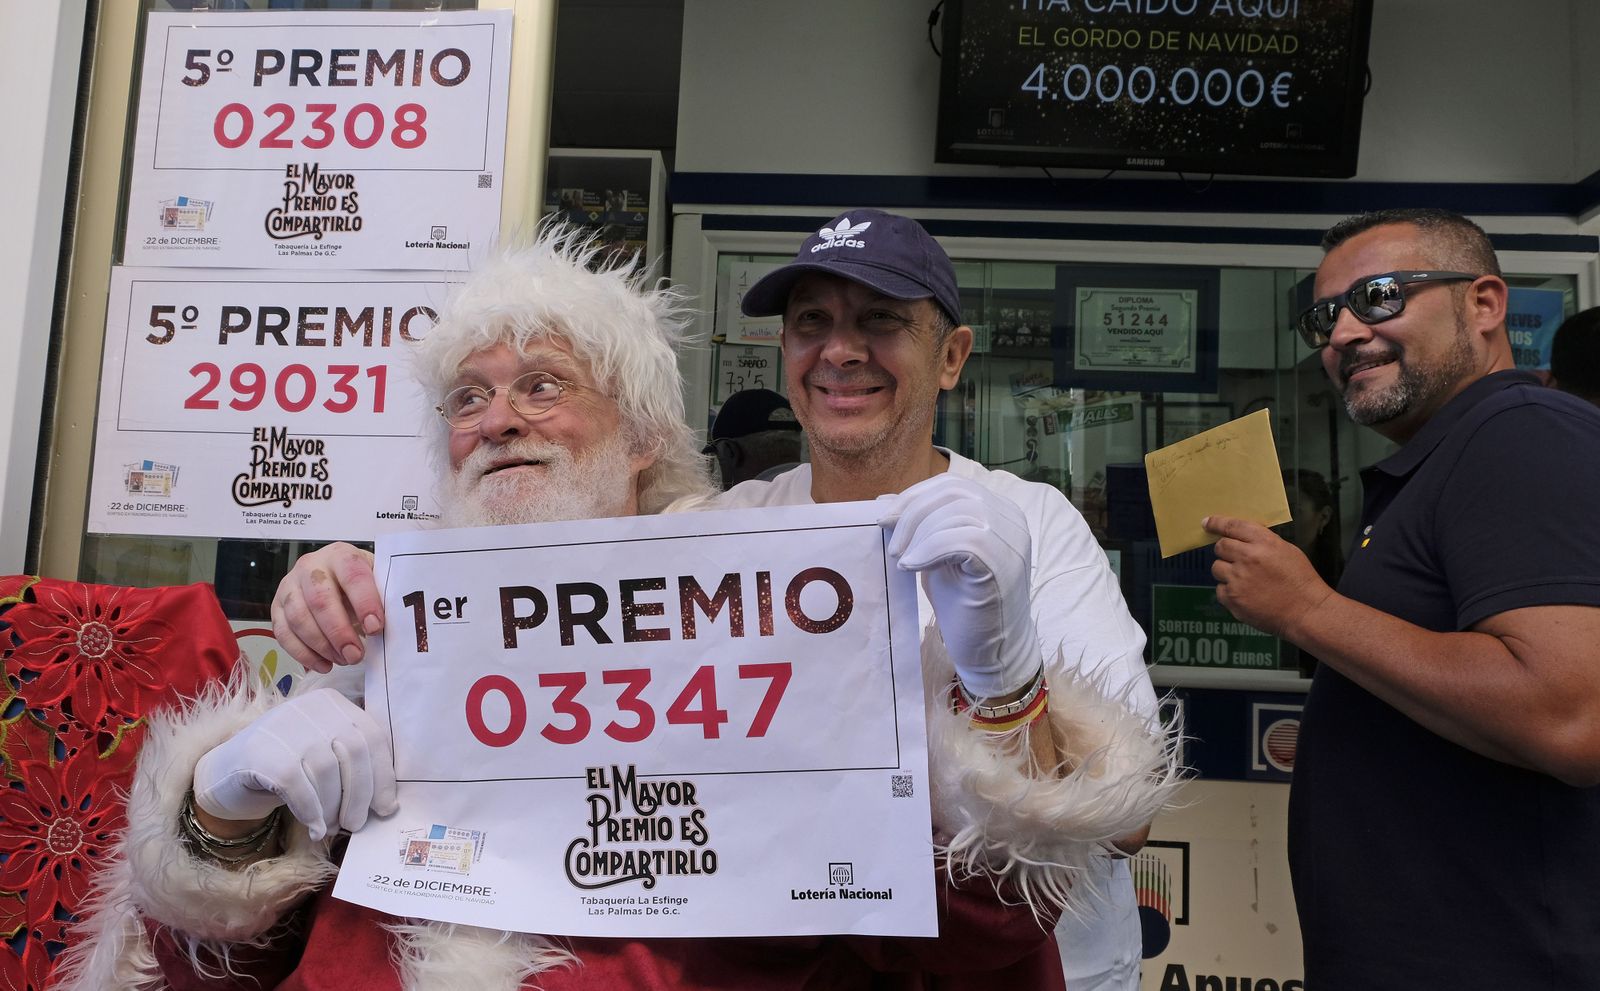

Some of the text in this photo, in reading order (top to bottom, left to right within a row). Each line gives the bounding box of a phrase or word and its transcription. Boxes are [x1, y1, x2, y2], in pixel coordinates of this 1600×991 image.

[1018, 26, 1299, 54] EL GORDO DE NAVIDAD
[253, 47, 471, 87] PREMIO
[1020, 62, 1295, 108] 4.000.000€
[213, 102, 428, 150] 02308
[1126, 157, 1166, 166] SAMSUNG
[286, 162, 355, 195] EL MAYOR
[282, 180, 337, 214] PREMIO
[265, 207, 363, 240] COMPARTIRLO
[146, 237, 218, 245] 22 de DICIEMBRE
[435, 241, 470, 249] Nacional
[811, 237, 866, 253] adidas
[1118, 296, 1154, 304] DIPLOMA
[218, 305, 441, 347] PREMIO
[1143, 328, 1164, 336] AQUÍ
[183, 362, 388, 413] 29031
[253, 426, 325, 461] EL MAYOR
[249, 445, 306, 480] PREMIO
[110, 502, 185, 512] 22 de DICIEMBRE
[231, 473, 333, 508] COMPARTIRLO
[499, 566, 854, 650] PREMIO
[1158, 620, 1203, 634] SORTEO
[1206, 622, 1220, 634] DE
[1158, 636, 1273, 666] 20,00 EUROS
[465, 661, 793, 748] 03347
[586, 764, 697, 816] EL MAYOR
[586, 794, 673, 848] PREMIO
[565, 838, 718, 889] COMPARTIRLO
[373, 874, 492, 897] 22 de DICIEMBRE
[394, 888, 454, 900] EXTRAORDINARIO
[580, 896, 689, 906] Tabaquería La Esfinge
[791, 888, 893, 900] Lotería Nacional
[588, 907, 605, 915] Las
[608, 907, 643, 915] Palmas
[645, 907, 659, 915] De
